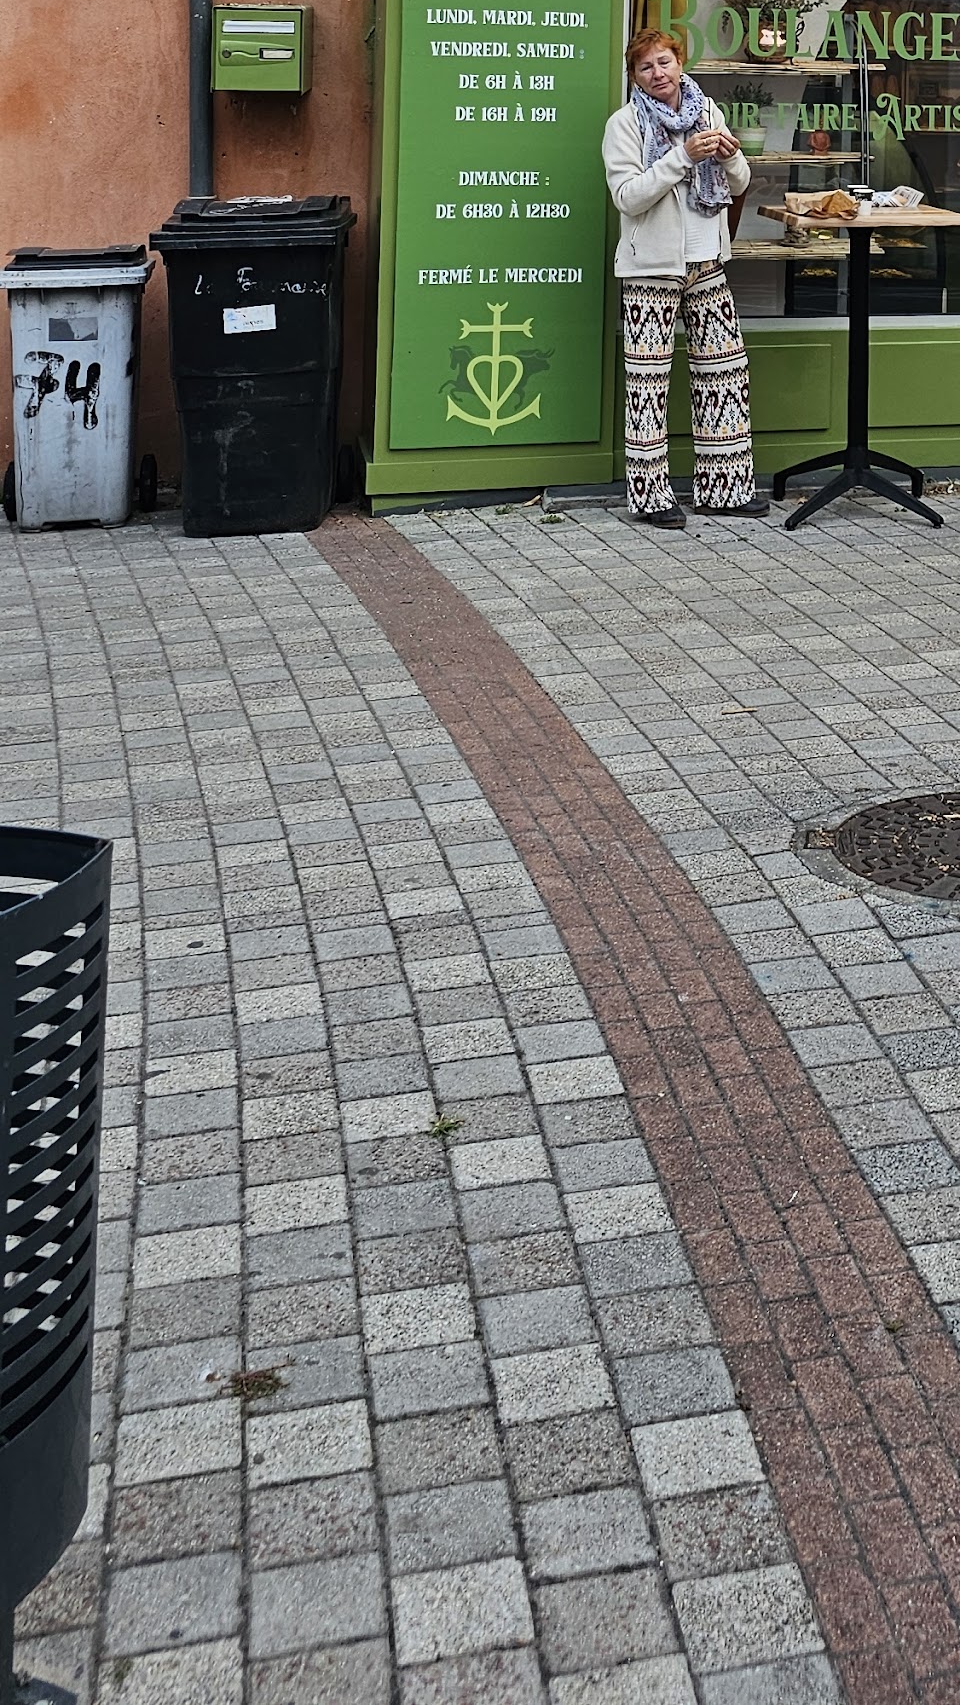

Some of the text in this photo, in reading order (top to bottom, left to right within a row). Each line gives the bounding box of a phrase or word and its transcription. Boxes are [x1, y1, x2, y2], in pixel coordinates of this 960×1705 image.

[427, 9, 589, 28] LUNDI, MARDI, JEUDI,
[430, 42, 511, 58] VENDREDI,
[516, 43, 575, 59] SAMEDI
[459, 71, 555, 91] DE 6H À 13H
[455, 103, 557, 122] DE 16H À 19H
[715, 102, 859, 131] OIR-FAIRE
[459, 171, 540, 186] DIMANCHE
[436, 199, 571, 219] DE 6H30 À 12H30
[418, 265, 583, 285] FERMÉ LE MERCREDI
[15, 351, 101, 430] 74
